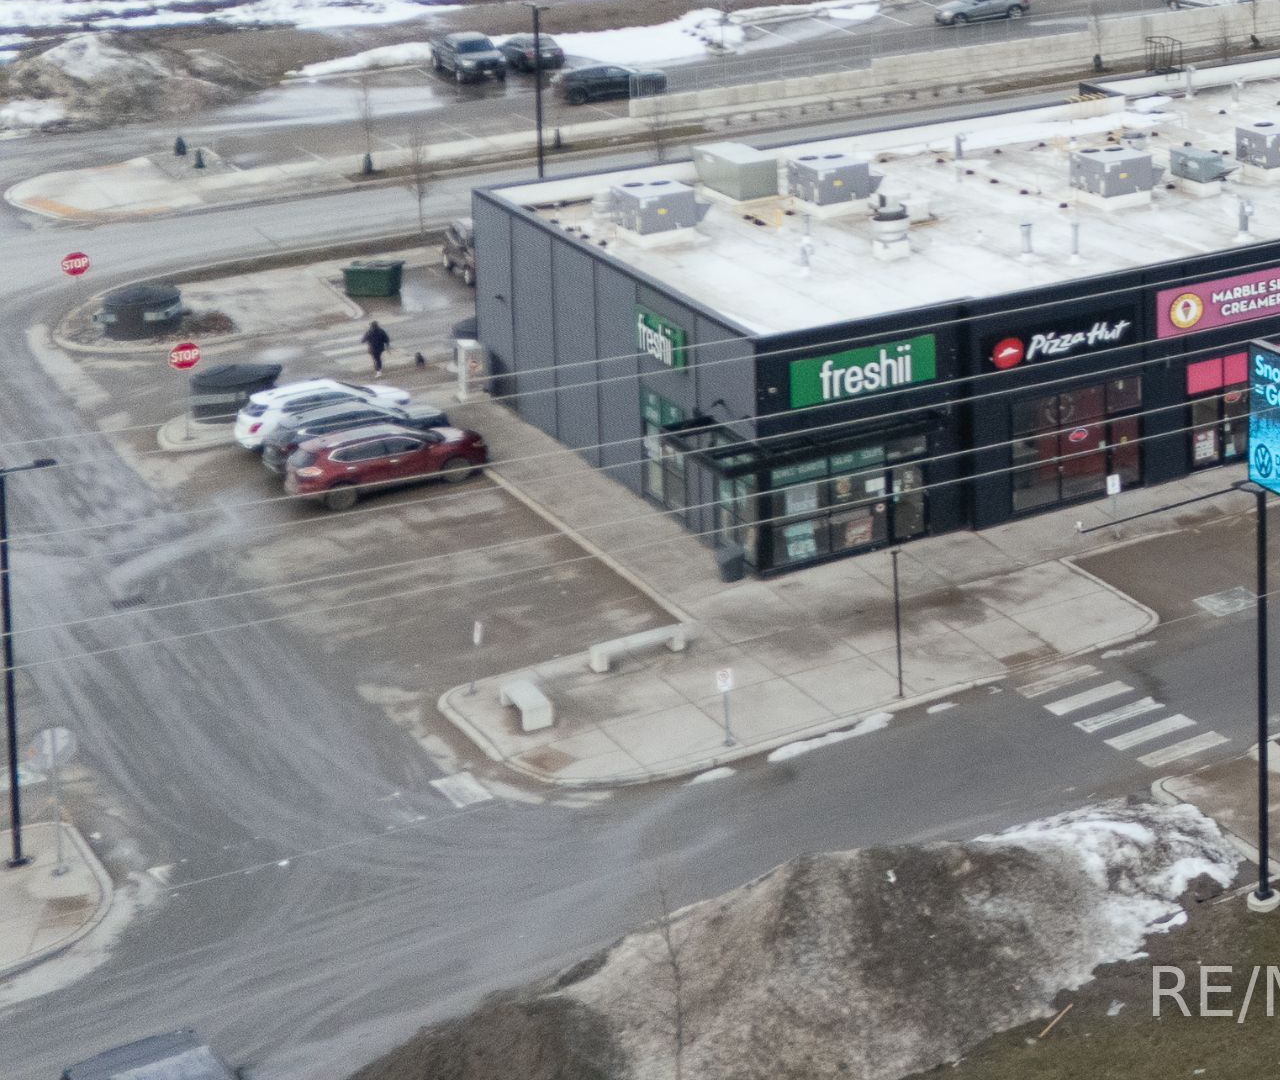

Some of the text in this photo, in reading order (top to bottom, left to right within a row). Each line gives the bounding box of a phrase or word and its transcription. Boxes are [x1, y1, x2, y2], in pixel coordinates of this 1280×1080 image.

[62, 257, 89, 271] STOP
[1211, 280, 1267, 303] MARBLE
[171, 348, 199, 363] STOP
[638, 313, 672, 366] freshii
[1026, 320, 1132, 361] Pizza Hut
[819, 344, 912, 400] freshii
